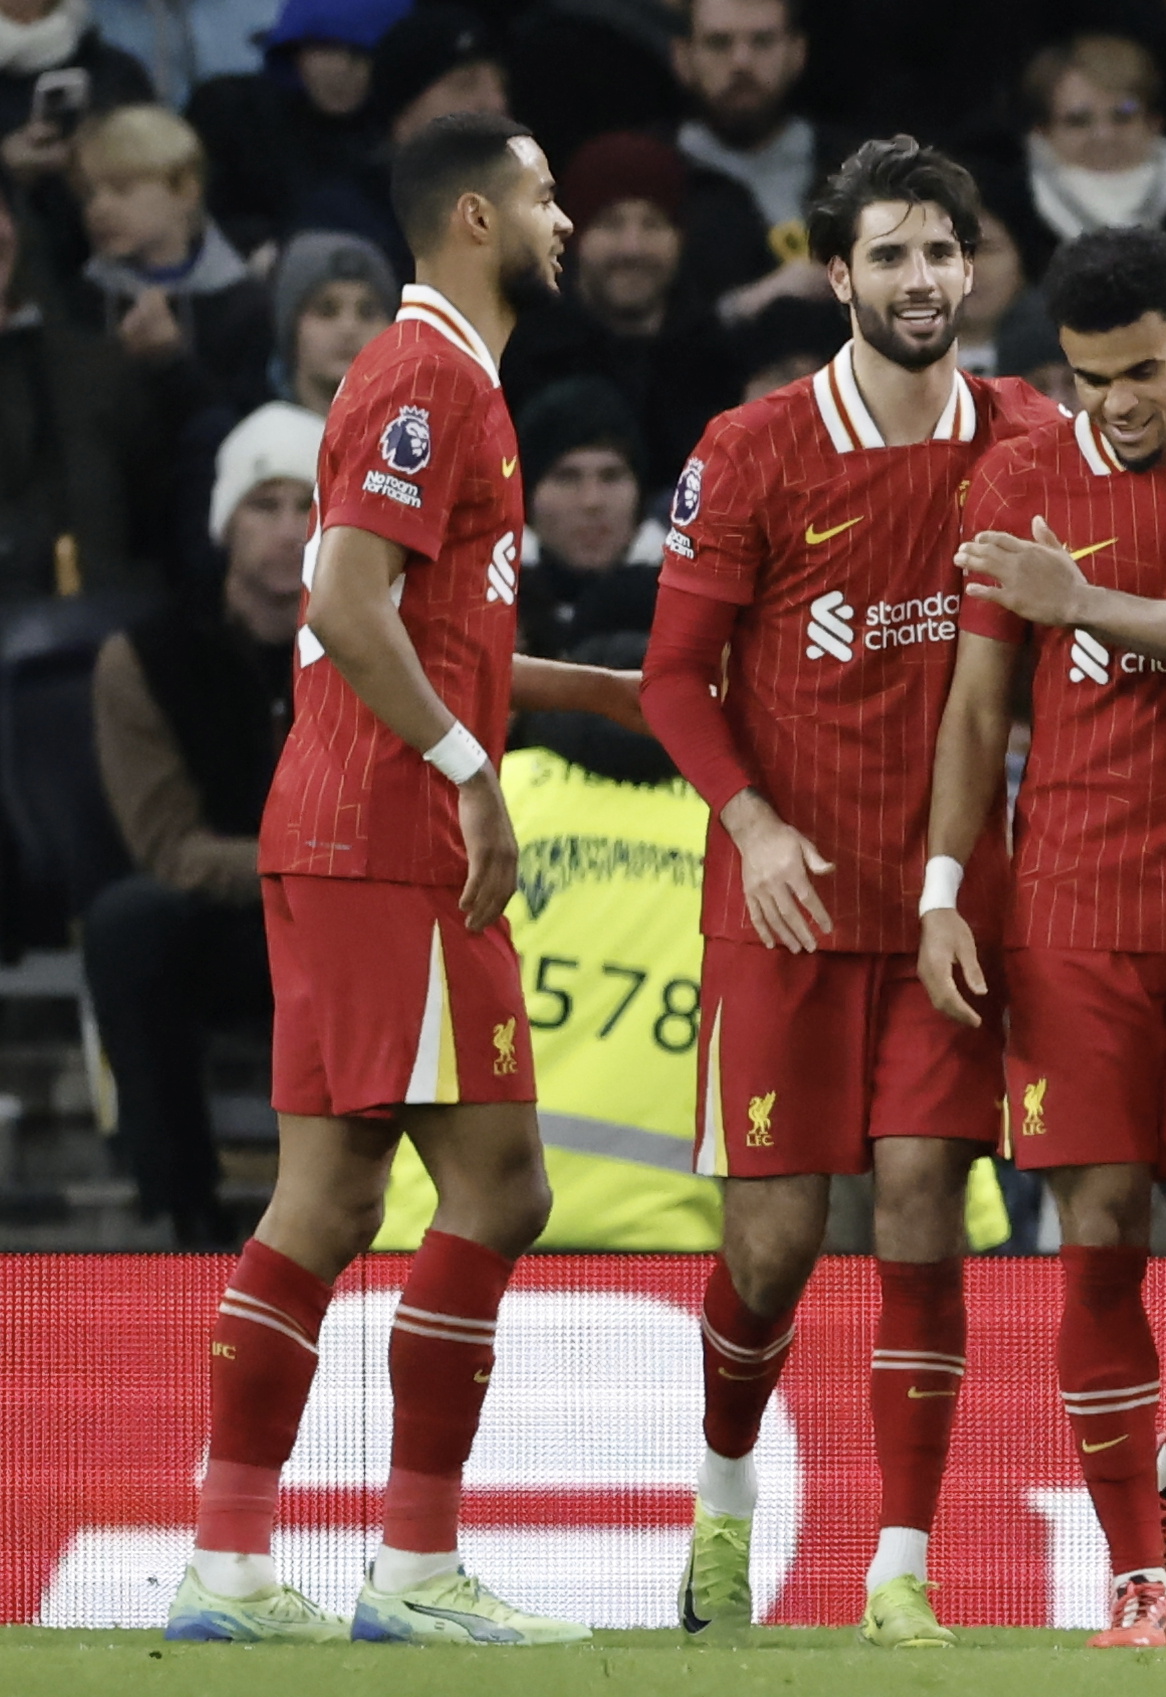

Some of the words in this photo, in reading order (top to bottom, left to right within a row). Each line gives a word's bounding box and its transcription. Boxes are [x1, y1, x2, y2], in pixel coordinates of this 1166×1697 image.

[866, 591, 960, 626] standa
[865, 618, 956, 650] charte
[528, 955, 699, 1053] 578
[746, 1133, 775, 1147] LFC
